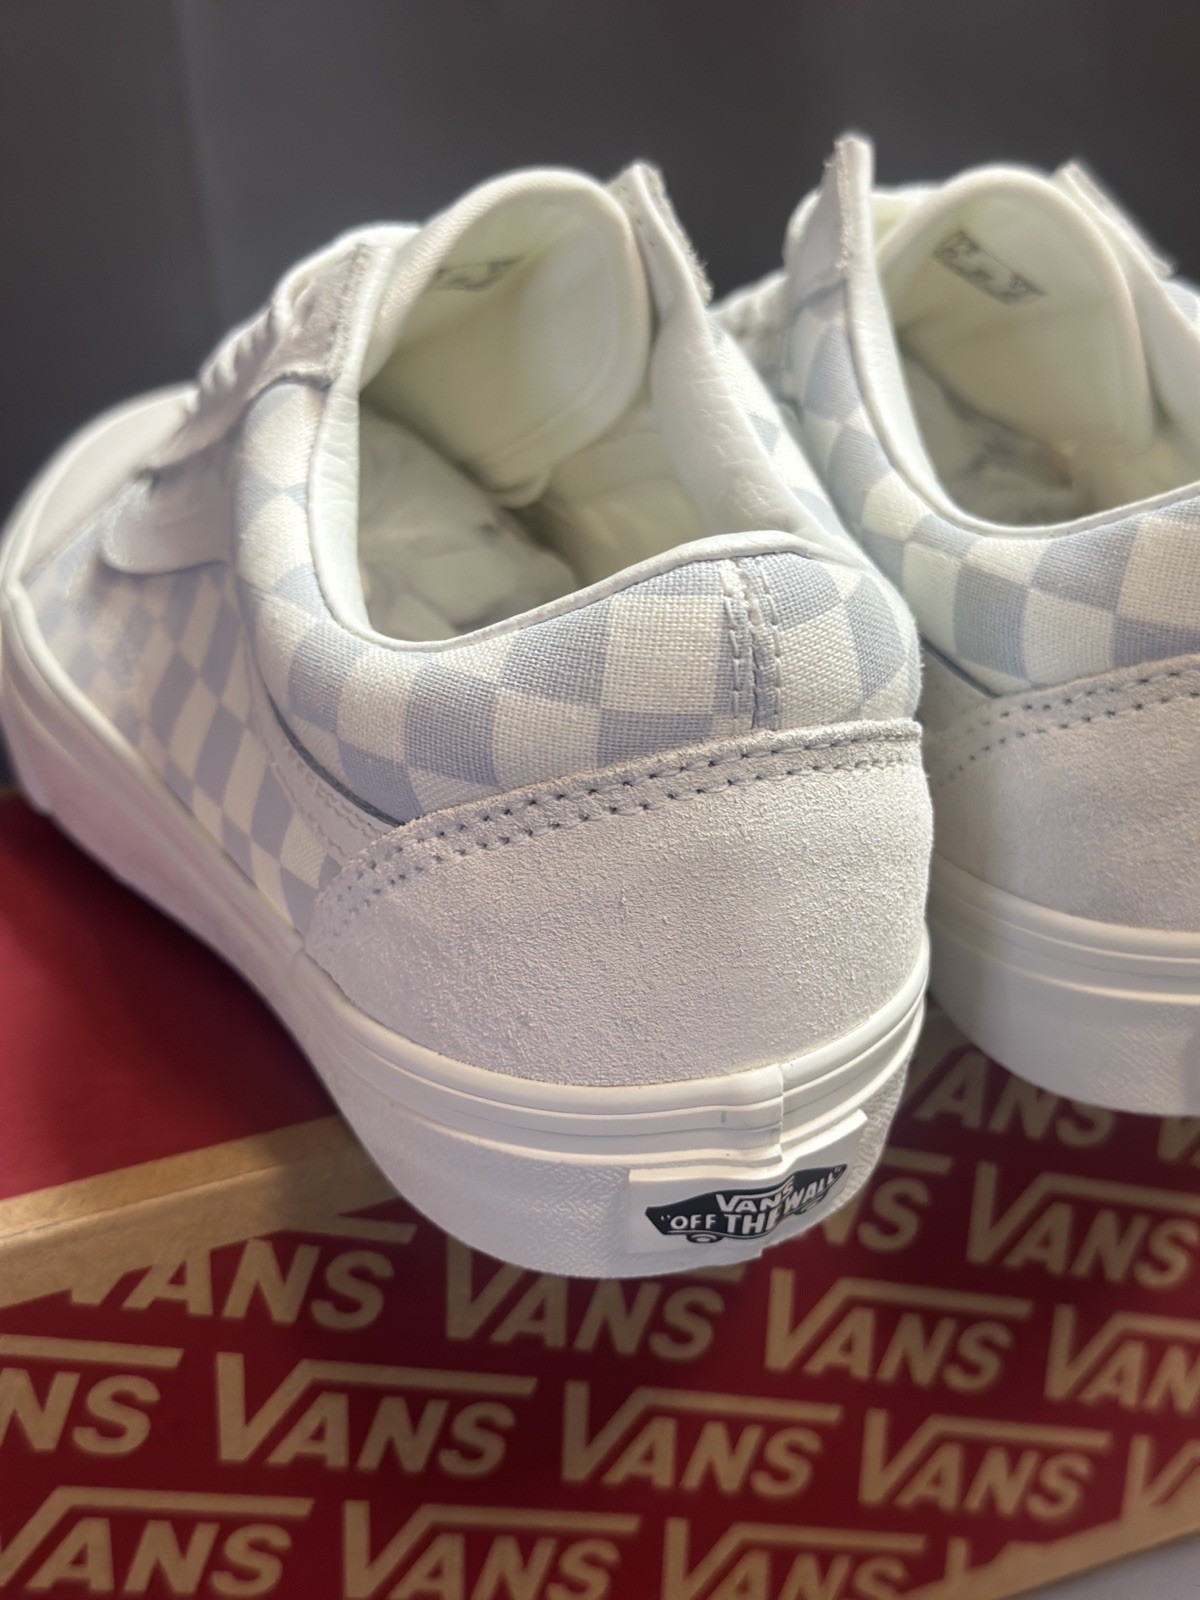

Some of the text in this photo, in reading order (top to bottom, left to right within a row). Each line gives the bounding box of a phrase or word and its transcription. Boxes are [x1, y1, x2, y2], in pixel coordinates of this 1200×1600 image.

[715, 1175, 796, 1213] VANS
[724, 1207, 783, 1235] THE
[966, 1160, 1200, 1289] VANS
[71, 1214, 1200, 1413] ANS VANS VANS VAN
[216, 1352, 538, 1476] VANS
[560, 1380, 842, 1498] VANS
[857, 1408, 1113, 1519] VANS
[342, 1500, 641, 1600] VANS
[661, 1517, 926, 1600] VANS
